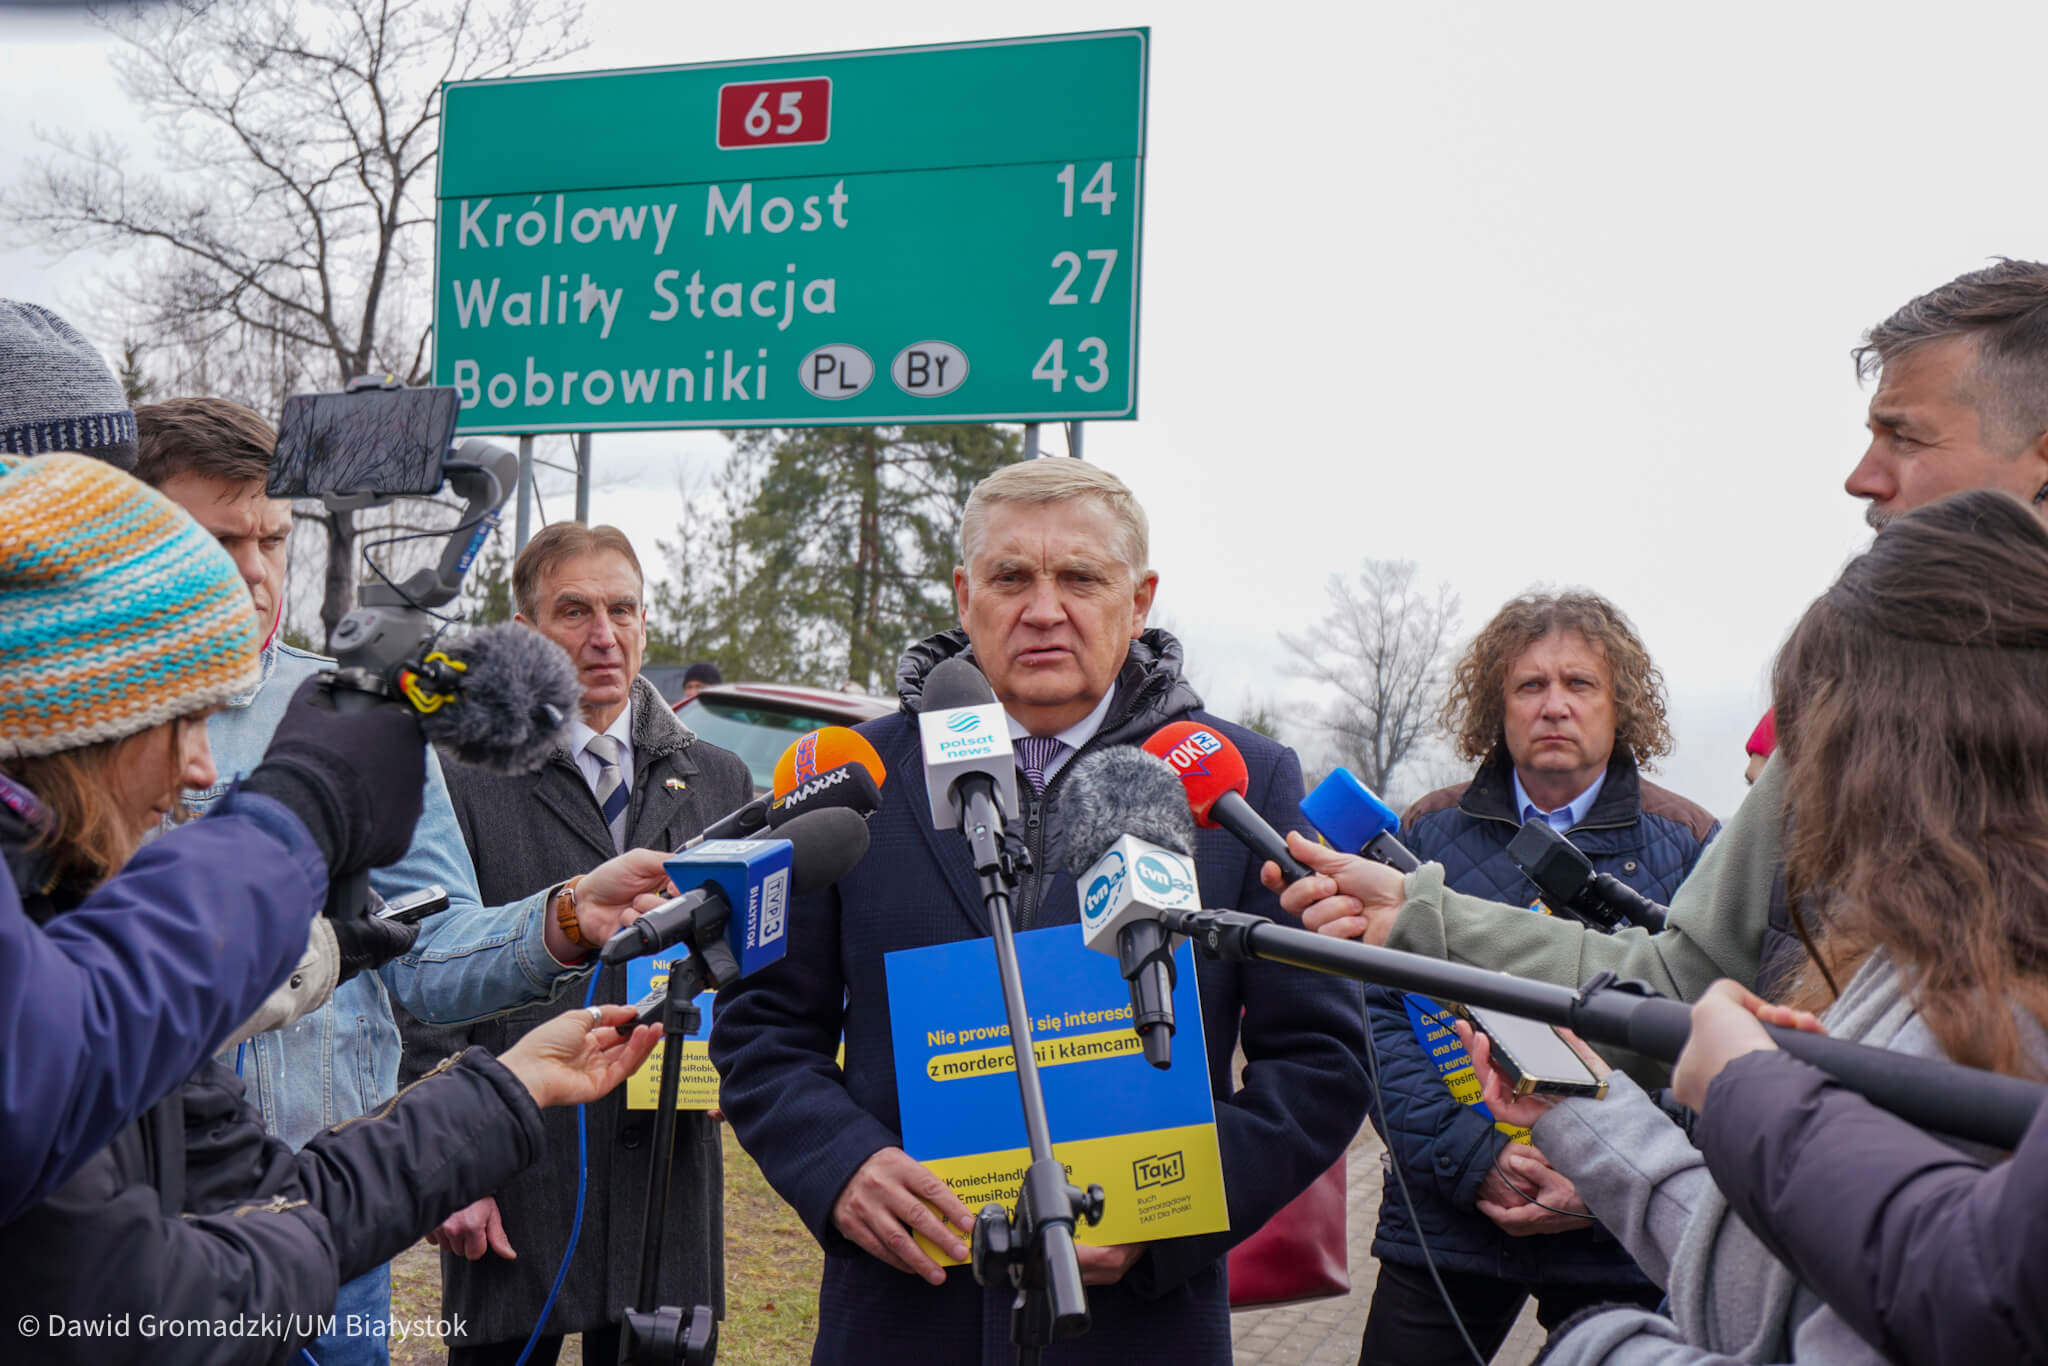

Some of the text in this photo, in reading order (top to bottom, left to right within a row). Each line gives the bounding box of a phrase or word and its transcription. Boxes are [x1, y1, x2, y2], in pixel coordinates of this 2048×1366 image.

[744, 91, 803, 137] 65
[459, 162, 1118, 254] Królowy Most 14
[453, 248, 1119, 339] Waliły Stacja 27
[454, 336, 1110, 409] Bobrowniki PL BY 43
[940, 735, 995, 752] polsat
[947, 746, 992, 758] news
[785, 767, 851, 809] MAXXX
[927, 1029, 956, 1047] Nie
[1037, 1014, 1061, 1031] się
[1064, 1003, 1133, 1027] interesó
[930, 1064, 939, 1077] z
[1050, 1045, 1055, 1060] i
[1060, 1036, 1141, 1059] kłamcam
[1444, 1055, 1472, 1070] europ
[1138, 1159, 1178, 1181] Tak!
